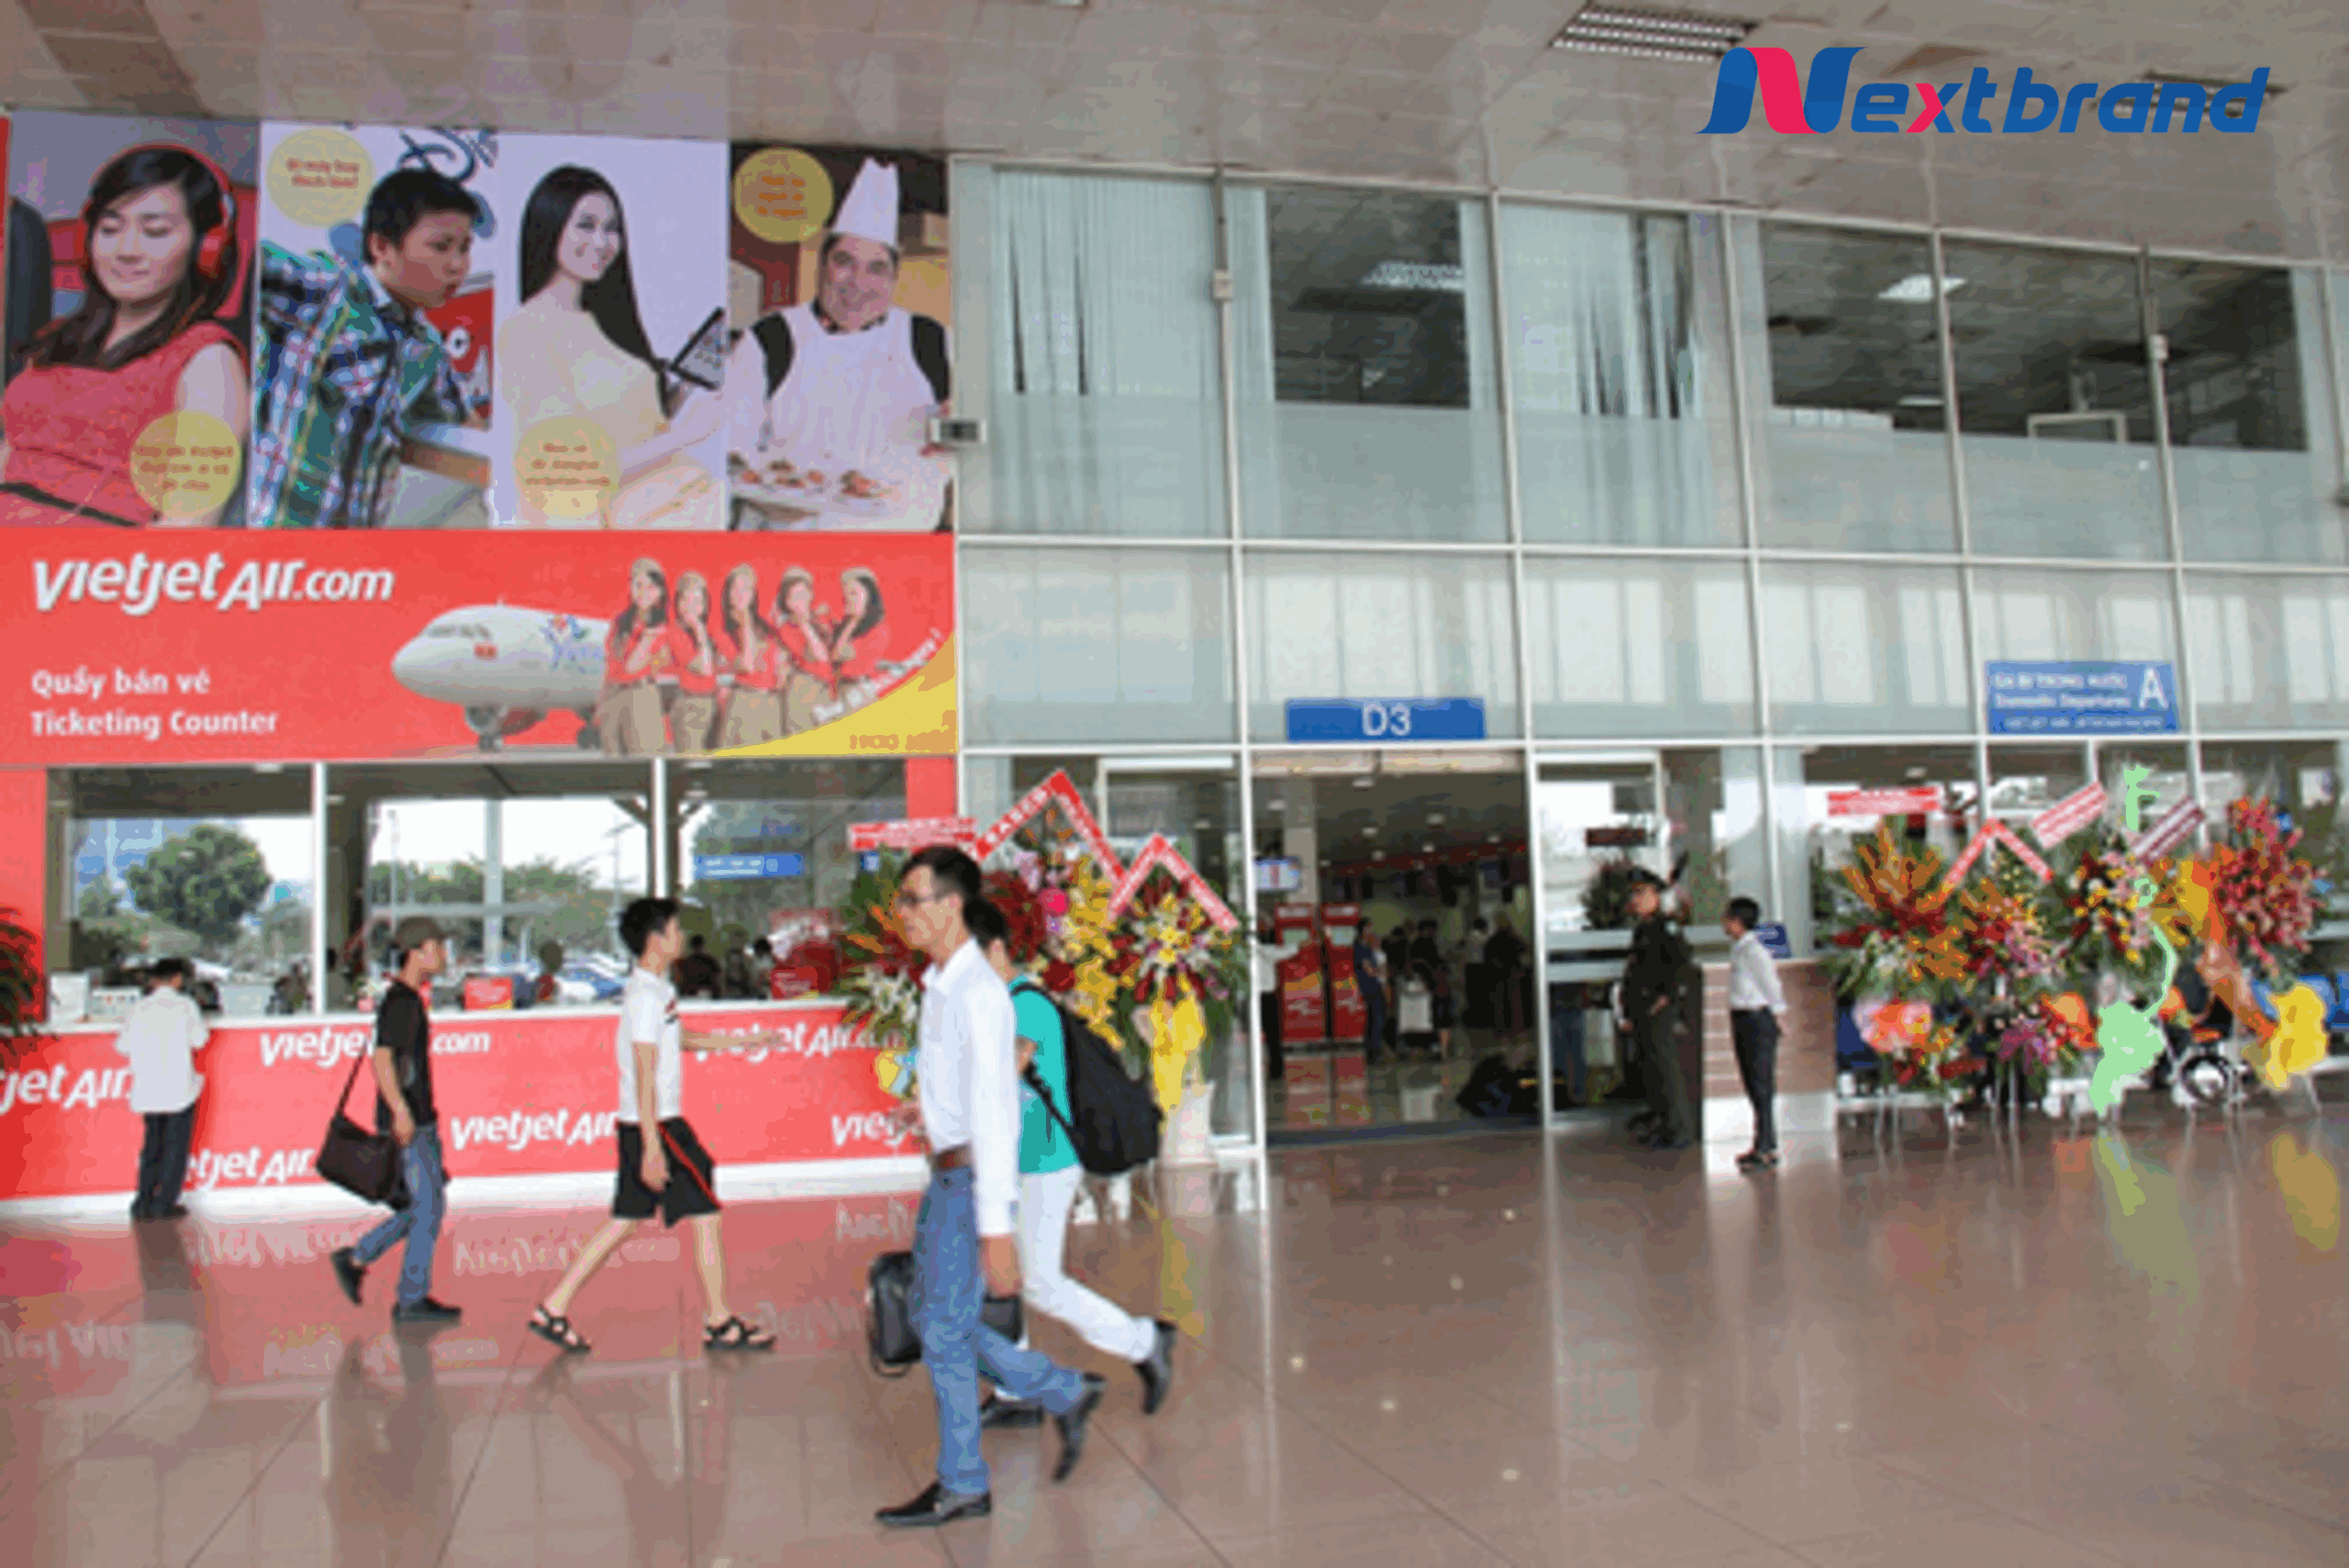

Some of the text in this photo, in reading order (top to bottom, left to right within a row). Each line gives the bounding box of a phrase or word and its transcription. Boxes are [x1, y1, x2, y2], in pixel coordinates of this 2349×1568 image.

[2138, 667, 2169, 708] A
[30, 707, 279, 741] Ticketing Counter
